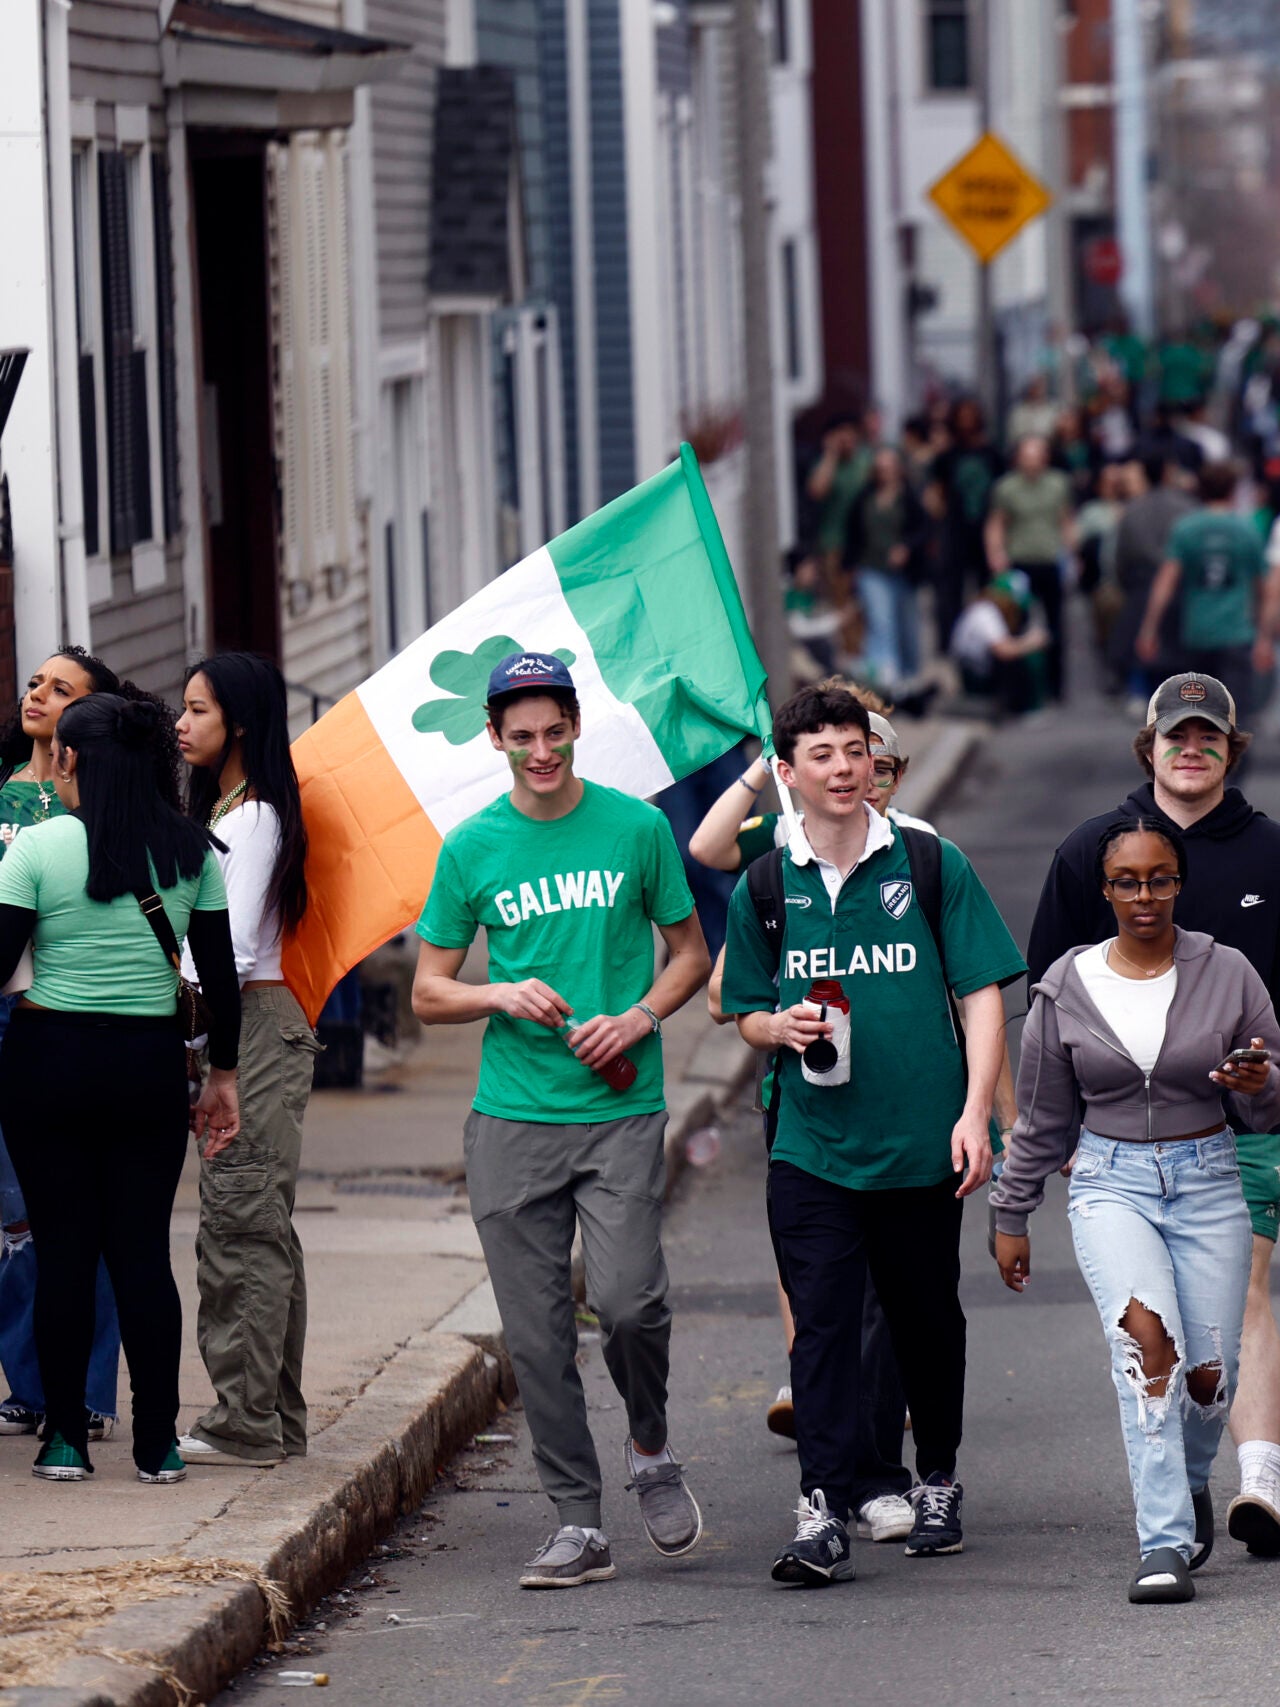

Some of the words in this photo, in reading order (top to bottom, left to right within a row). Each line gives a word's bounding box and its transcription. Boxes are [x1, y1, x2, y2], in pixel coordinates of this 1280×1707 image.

[494, 869, 625, 927] GALWAY
[887, 884, 910, 910] IRELAND
[1244, 894, 1260, 902] NIKE
[827, 1534, 844, 1560] N
